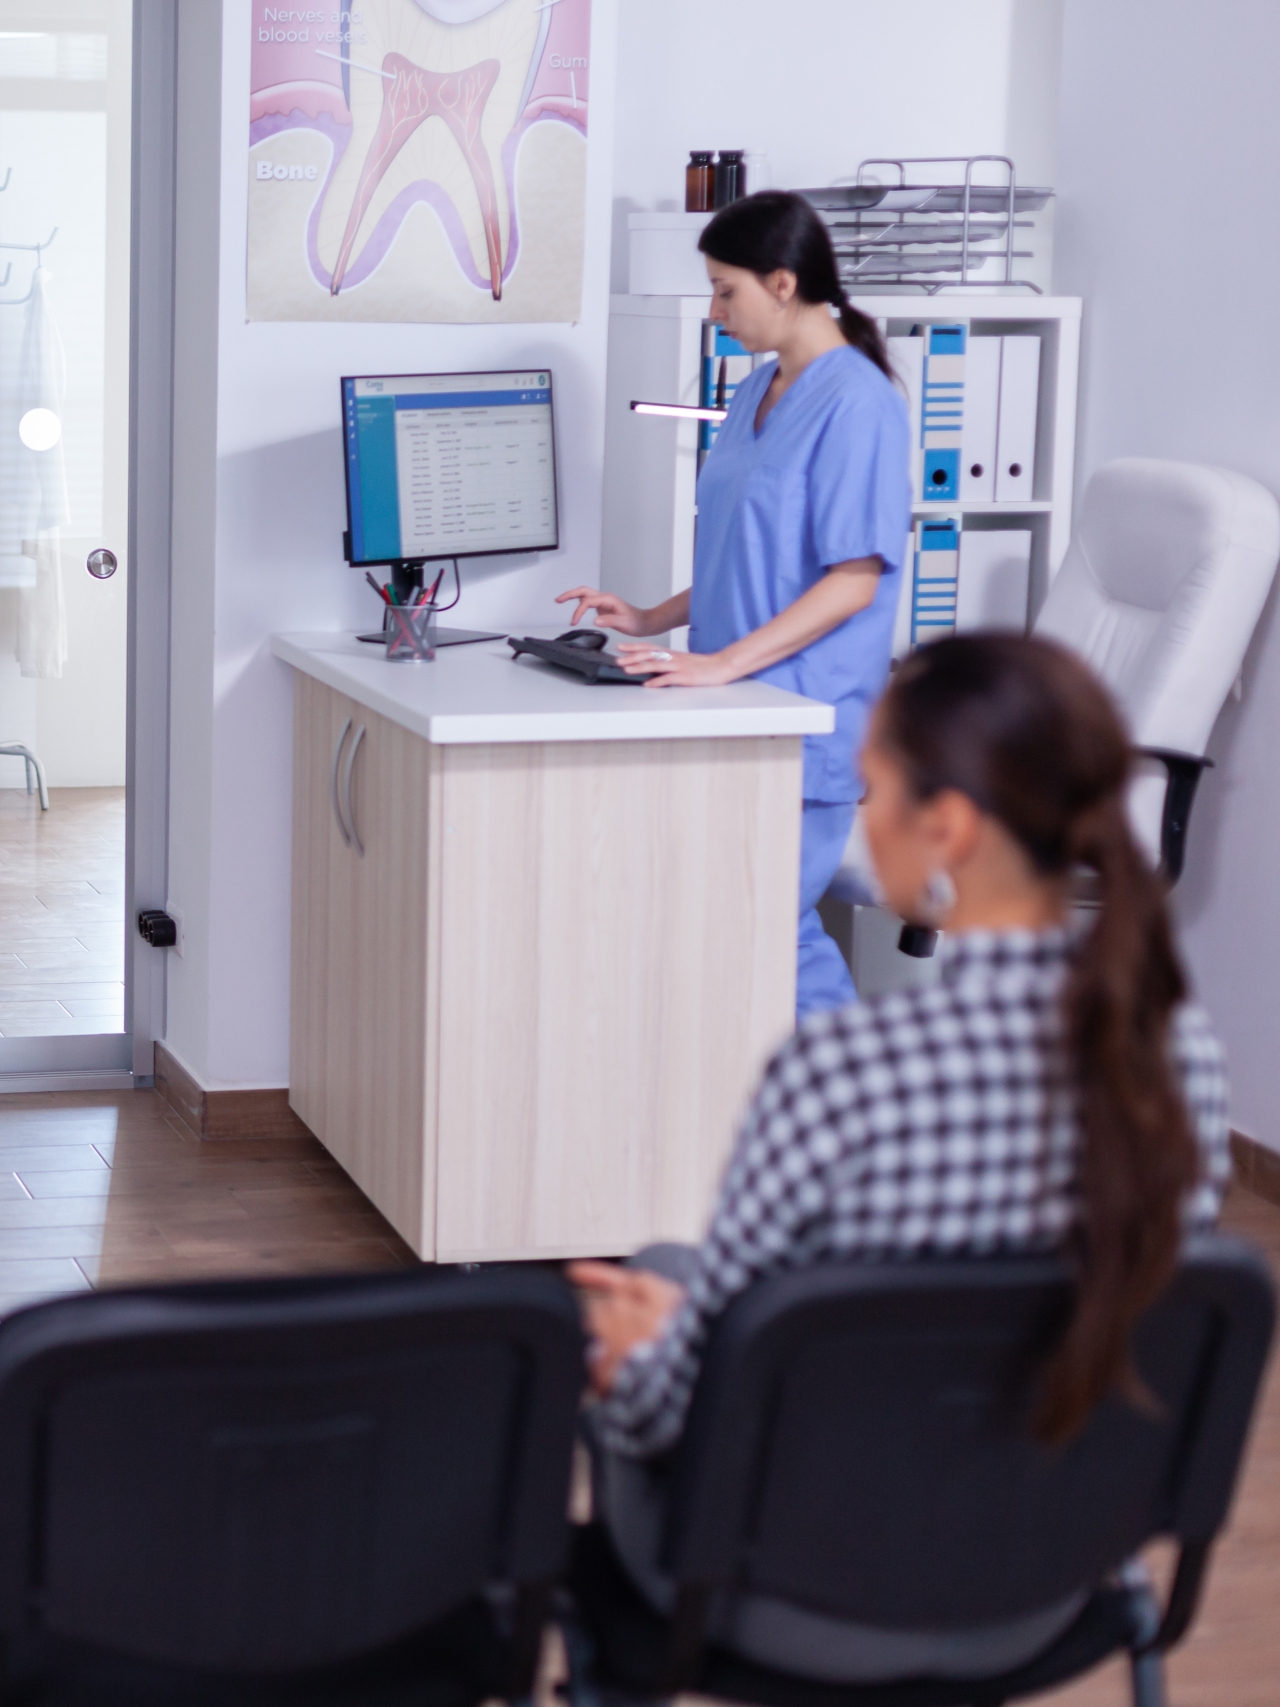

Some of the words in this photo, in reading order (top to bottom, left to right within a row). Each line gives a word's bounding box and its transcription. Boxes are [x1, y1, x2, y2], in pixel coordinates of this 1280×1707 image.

[263, 7, 325, 23] Nerves
[330, 9, 363, 23] and
[258, 26, 310, 43] blood
[315, 28, 368, 43] vesels
[549, 53, 587, 69] Gum
[256, 160, 319, 181] Bone
